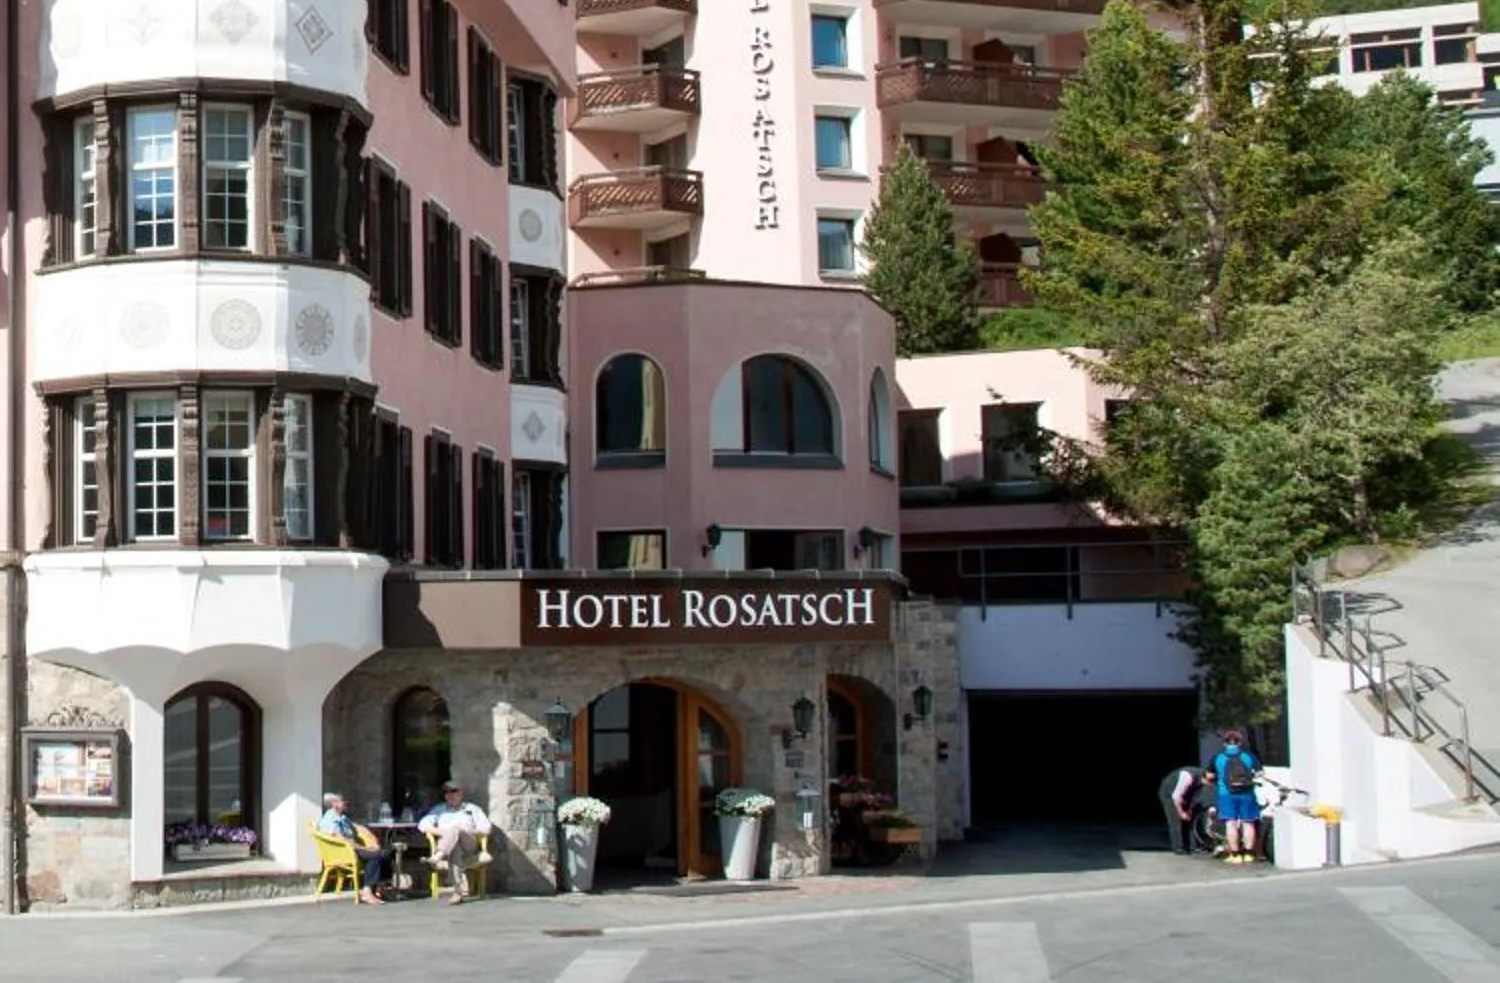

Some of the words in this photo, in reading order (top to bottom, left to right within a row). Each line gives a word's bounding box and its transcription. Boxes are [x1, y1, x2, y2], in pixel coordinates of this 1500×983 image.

[750, 26, 780, 231] ROSATSCH
[536, 588, 671, 629] HOTEL
[681, 588, 875, 628] ROSATSCH
